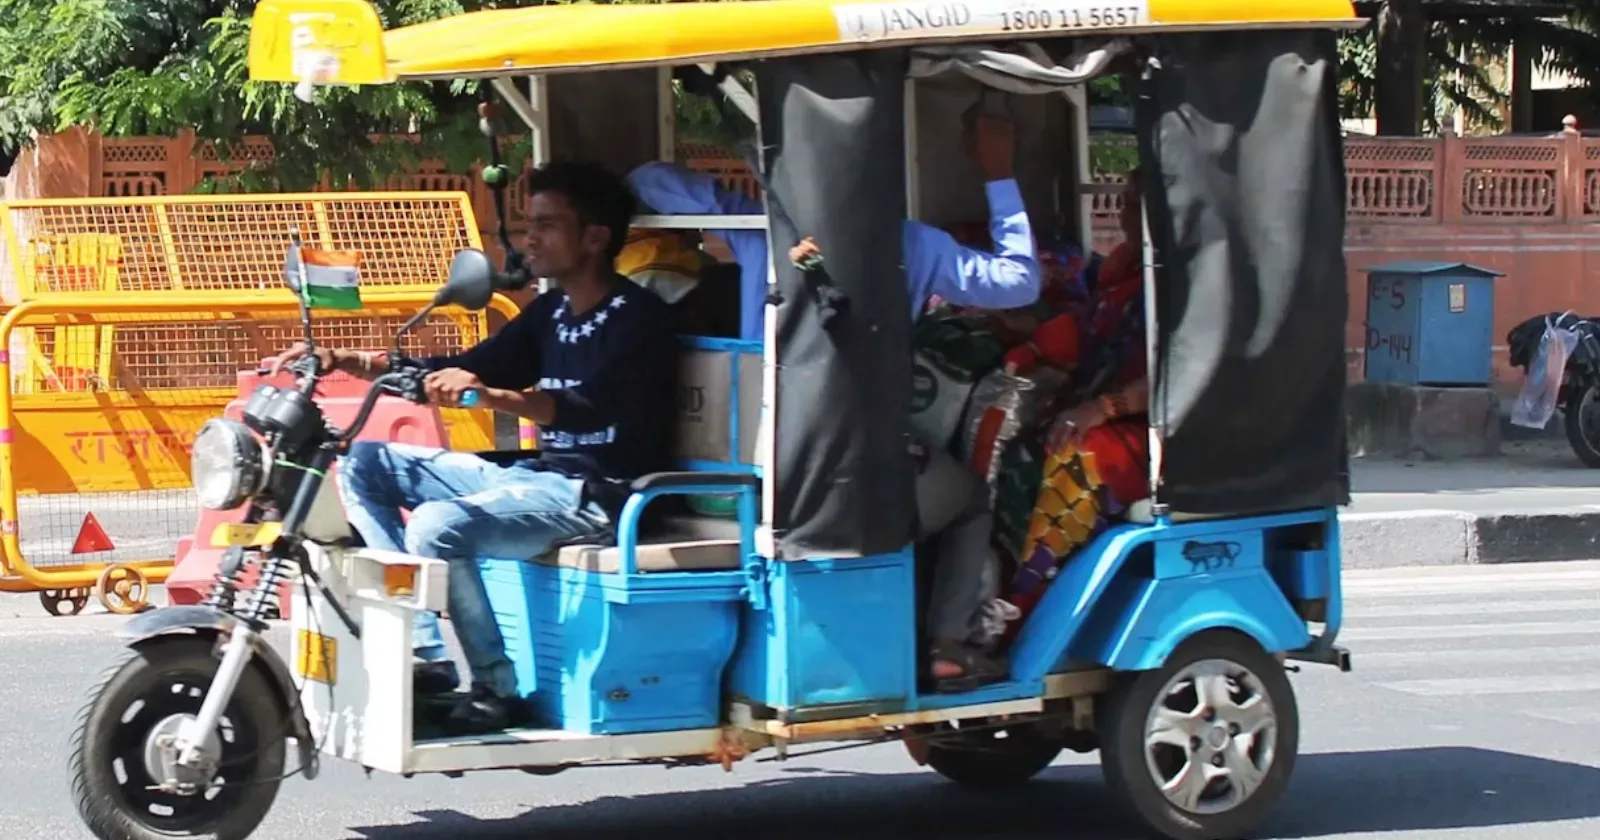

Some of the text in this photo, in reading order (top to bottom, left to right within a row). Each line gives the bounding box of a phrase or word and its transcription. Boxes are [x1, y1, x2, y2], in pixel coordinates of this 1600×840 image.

[880, 3, 971, 37] JANGID
[1001, 10, 1052, 31] 1800
[1060, 9, 1083, 28] 11
[1090, 6, 1139, 27] 5657
